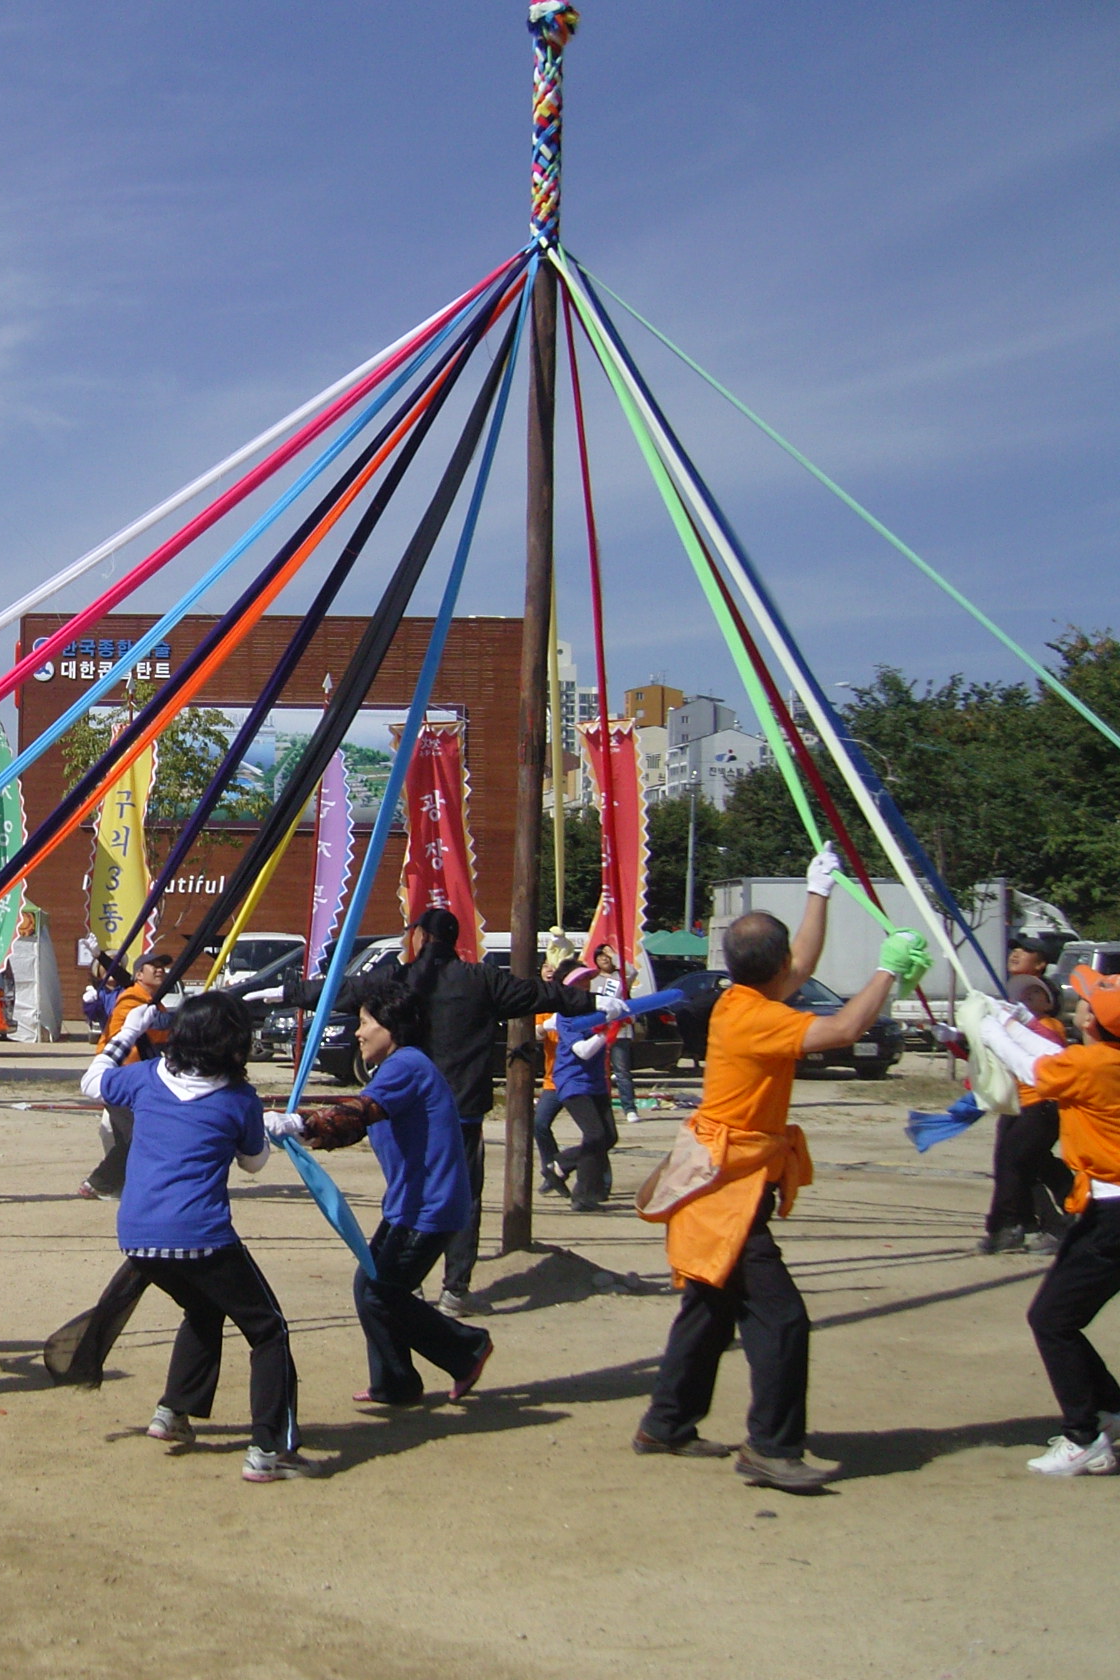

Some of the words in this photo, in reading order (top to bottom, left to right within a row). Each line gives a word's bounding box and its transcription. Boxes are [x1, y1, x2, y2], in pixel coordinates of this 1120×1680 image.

[62, 639, 171, 658] 한국종합술
[60, 660, 171, 680] 대한콘탄트
[98, 790, 136, 933] 구의3동
